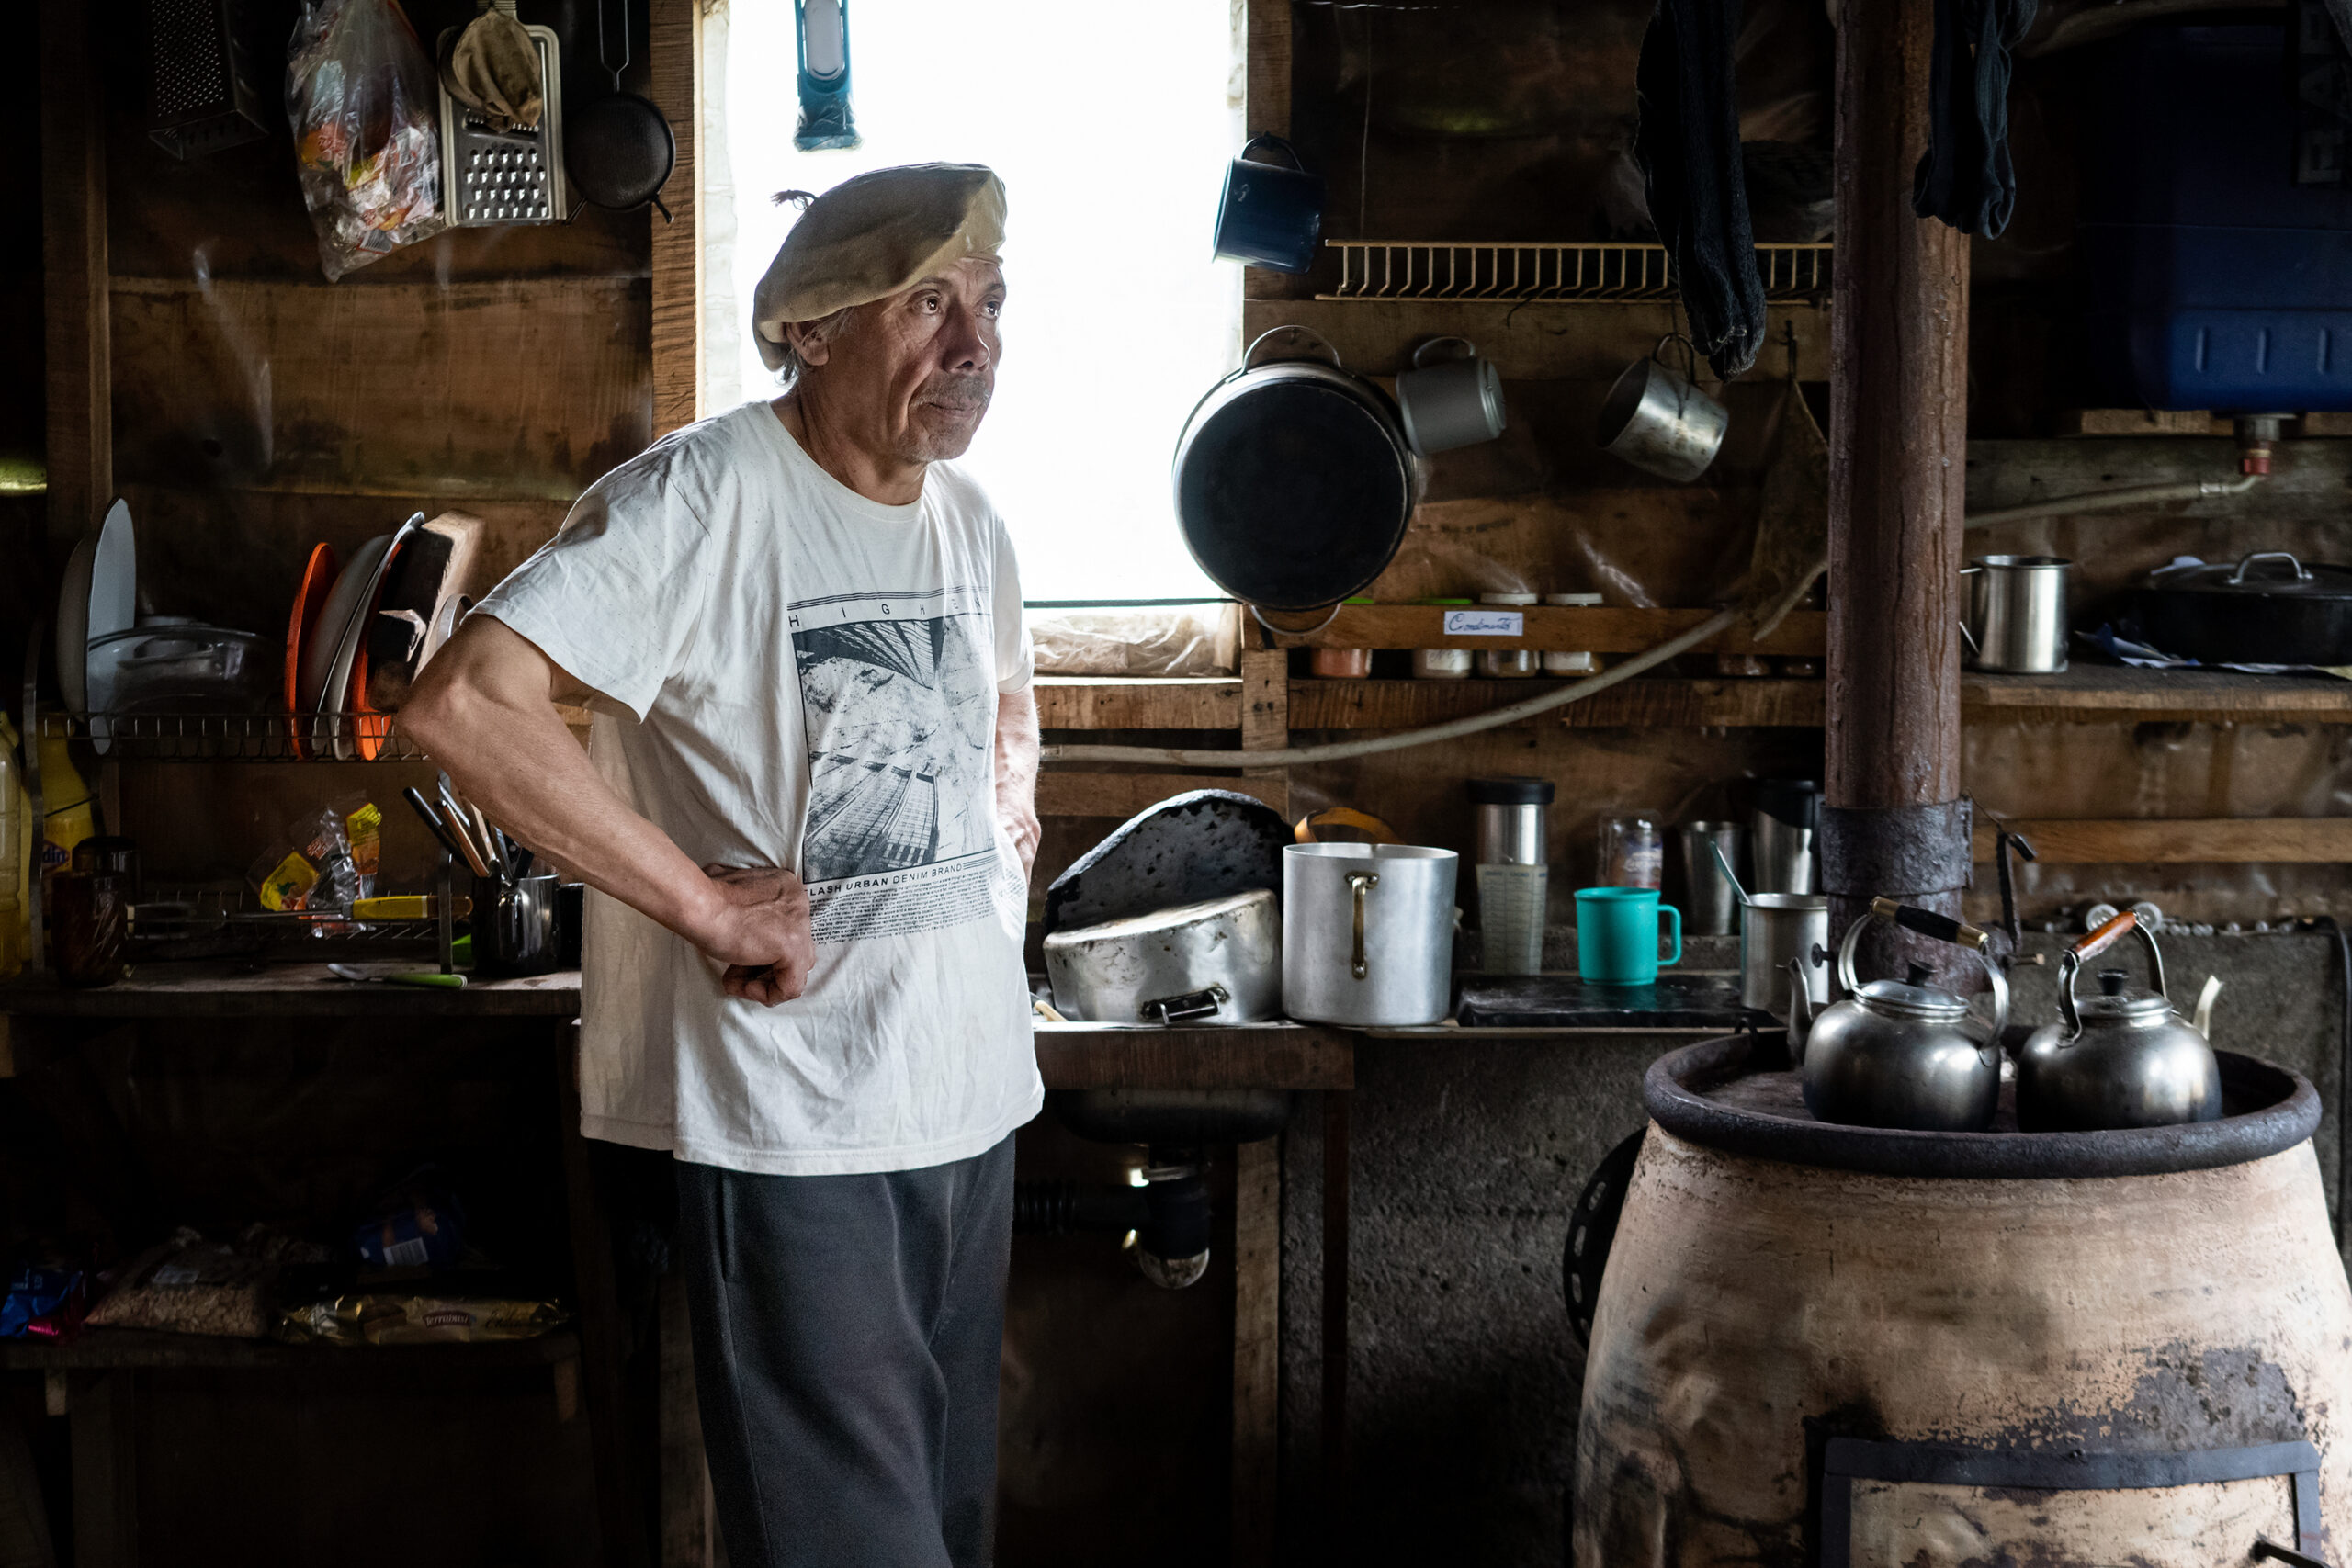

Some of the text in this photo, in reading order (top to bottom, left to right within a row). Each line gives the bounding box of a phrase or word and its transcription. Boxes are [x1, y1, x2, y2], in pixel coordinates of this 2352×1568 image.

[806, 863, 962, 897] LASH URBAN DENIM BRAND
